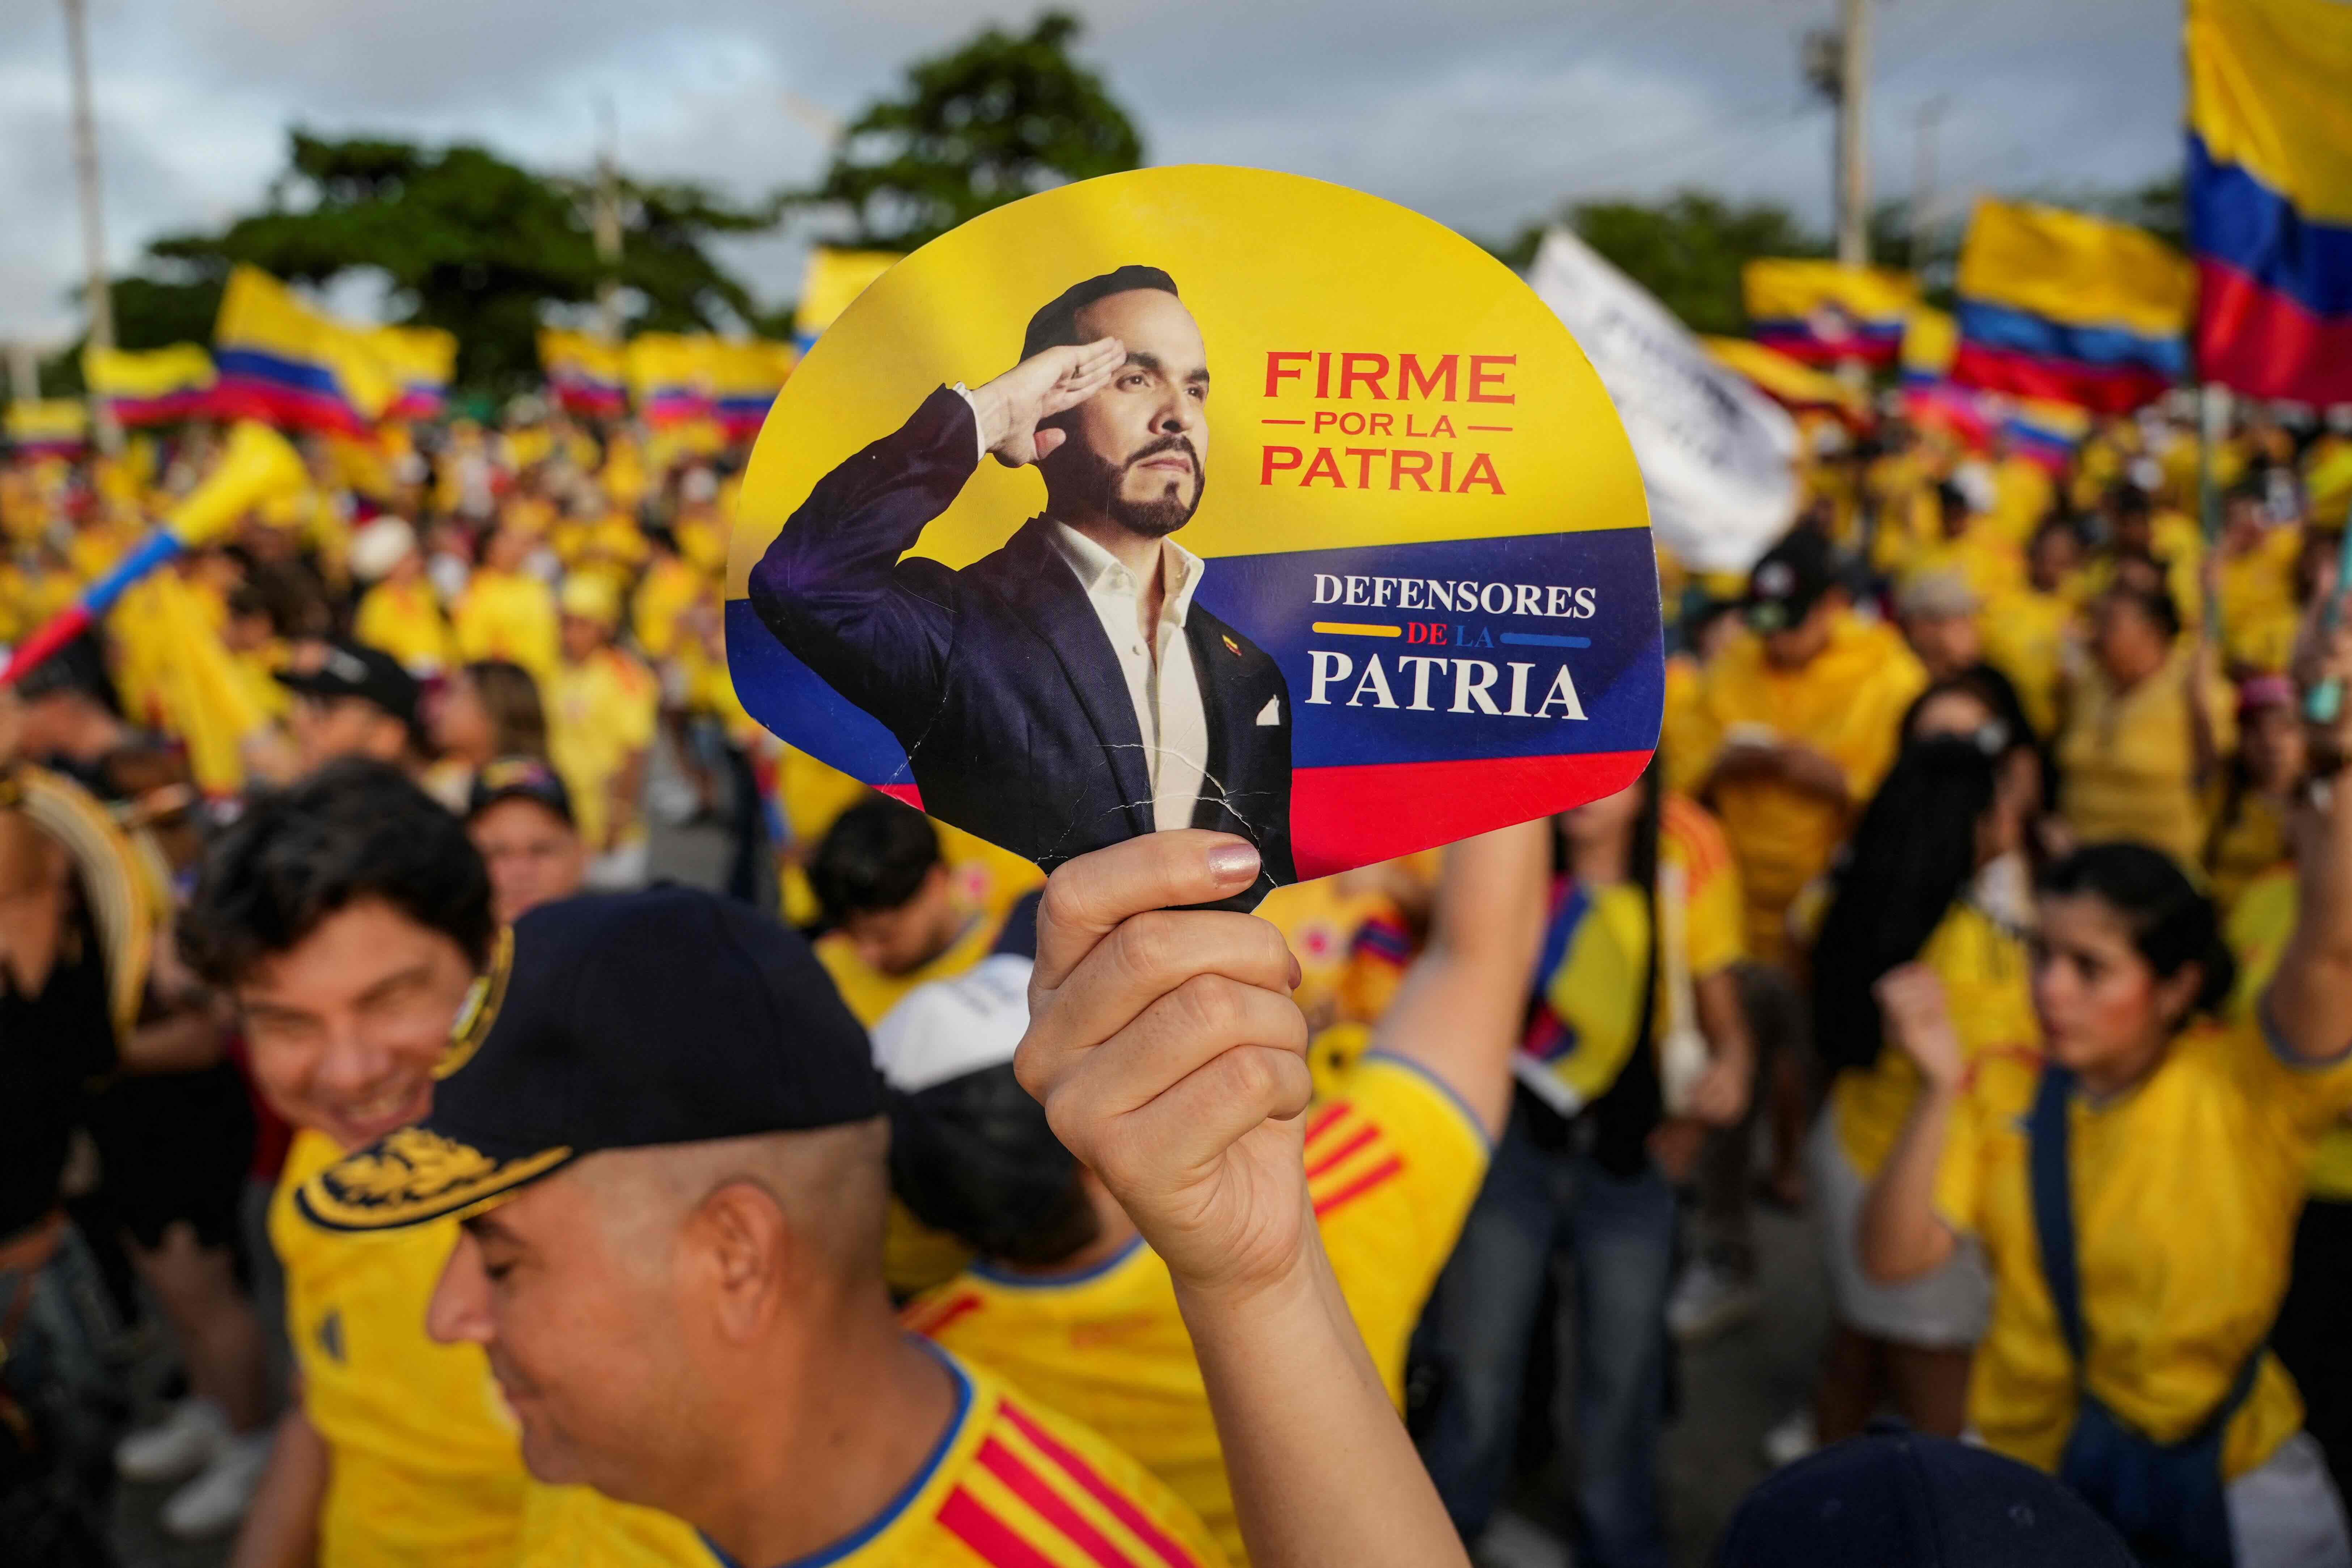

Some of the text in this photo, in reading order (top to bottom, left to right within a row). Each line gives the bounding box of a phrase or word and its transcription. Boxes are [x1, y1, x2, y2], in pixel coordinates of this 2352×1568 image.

[1264, 350, 1516, 405] FIRME
[1314, 412, 1456, 438] POR LA
[1260, 446, 1505, 495] PATRIA
[1312, 574, 1595, 618] DEFENSORES
[1407, 622, 1494, 647] DE LA
[1305, 651, 1588, 720] PATRIA
